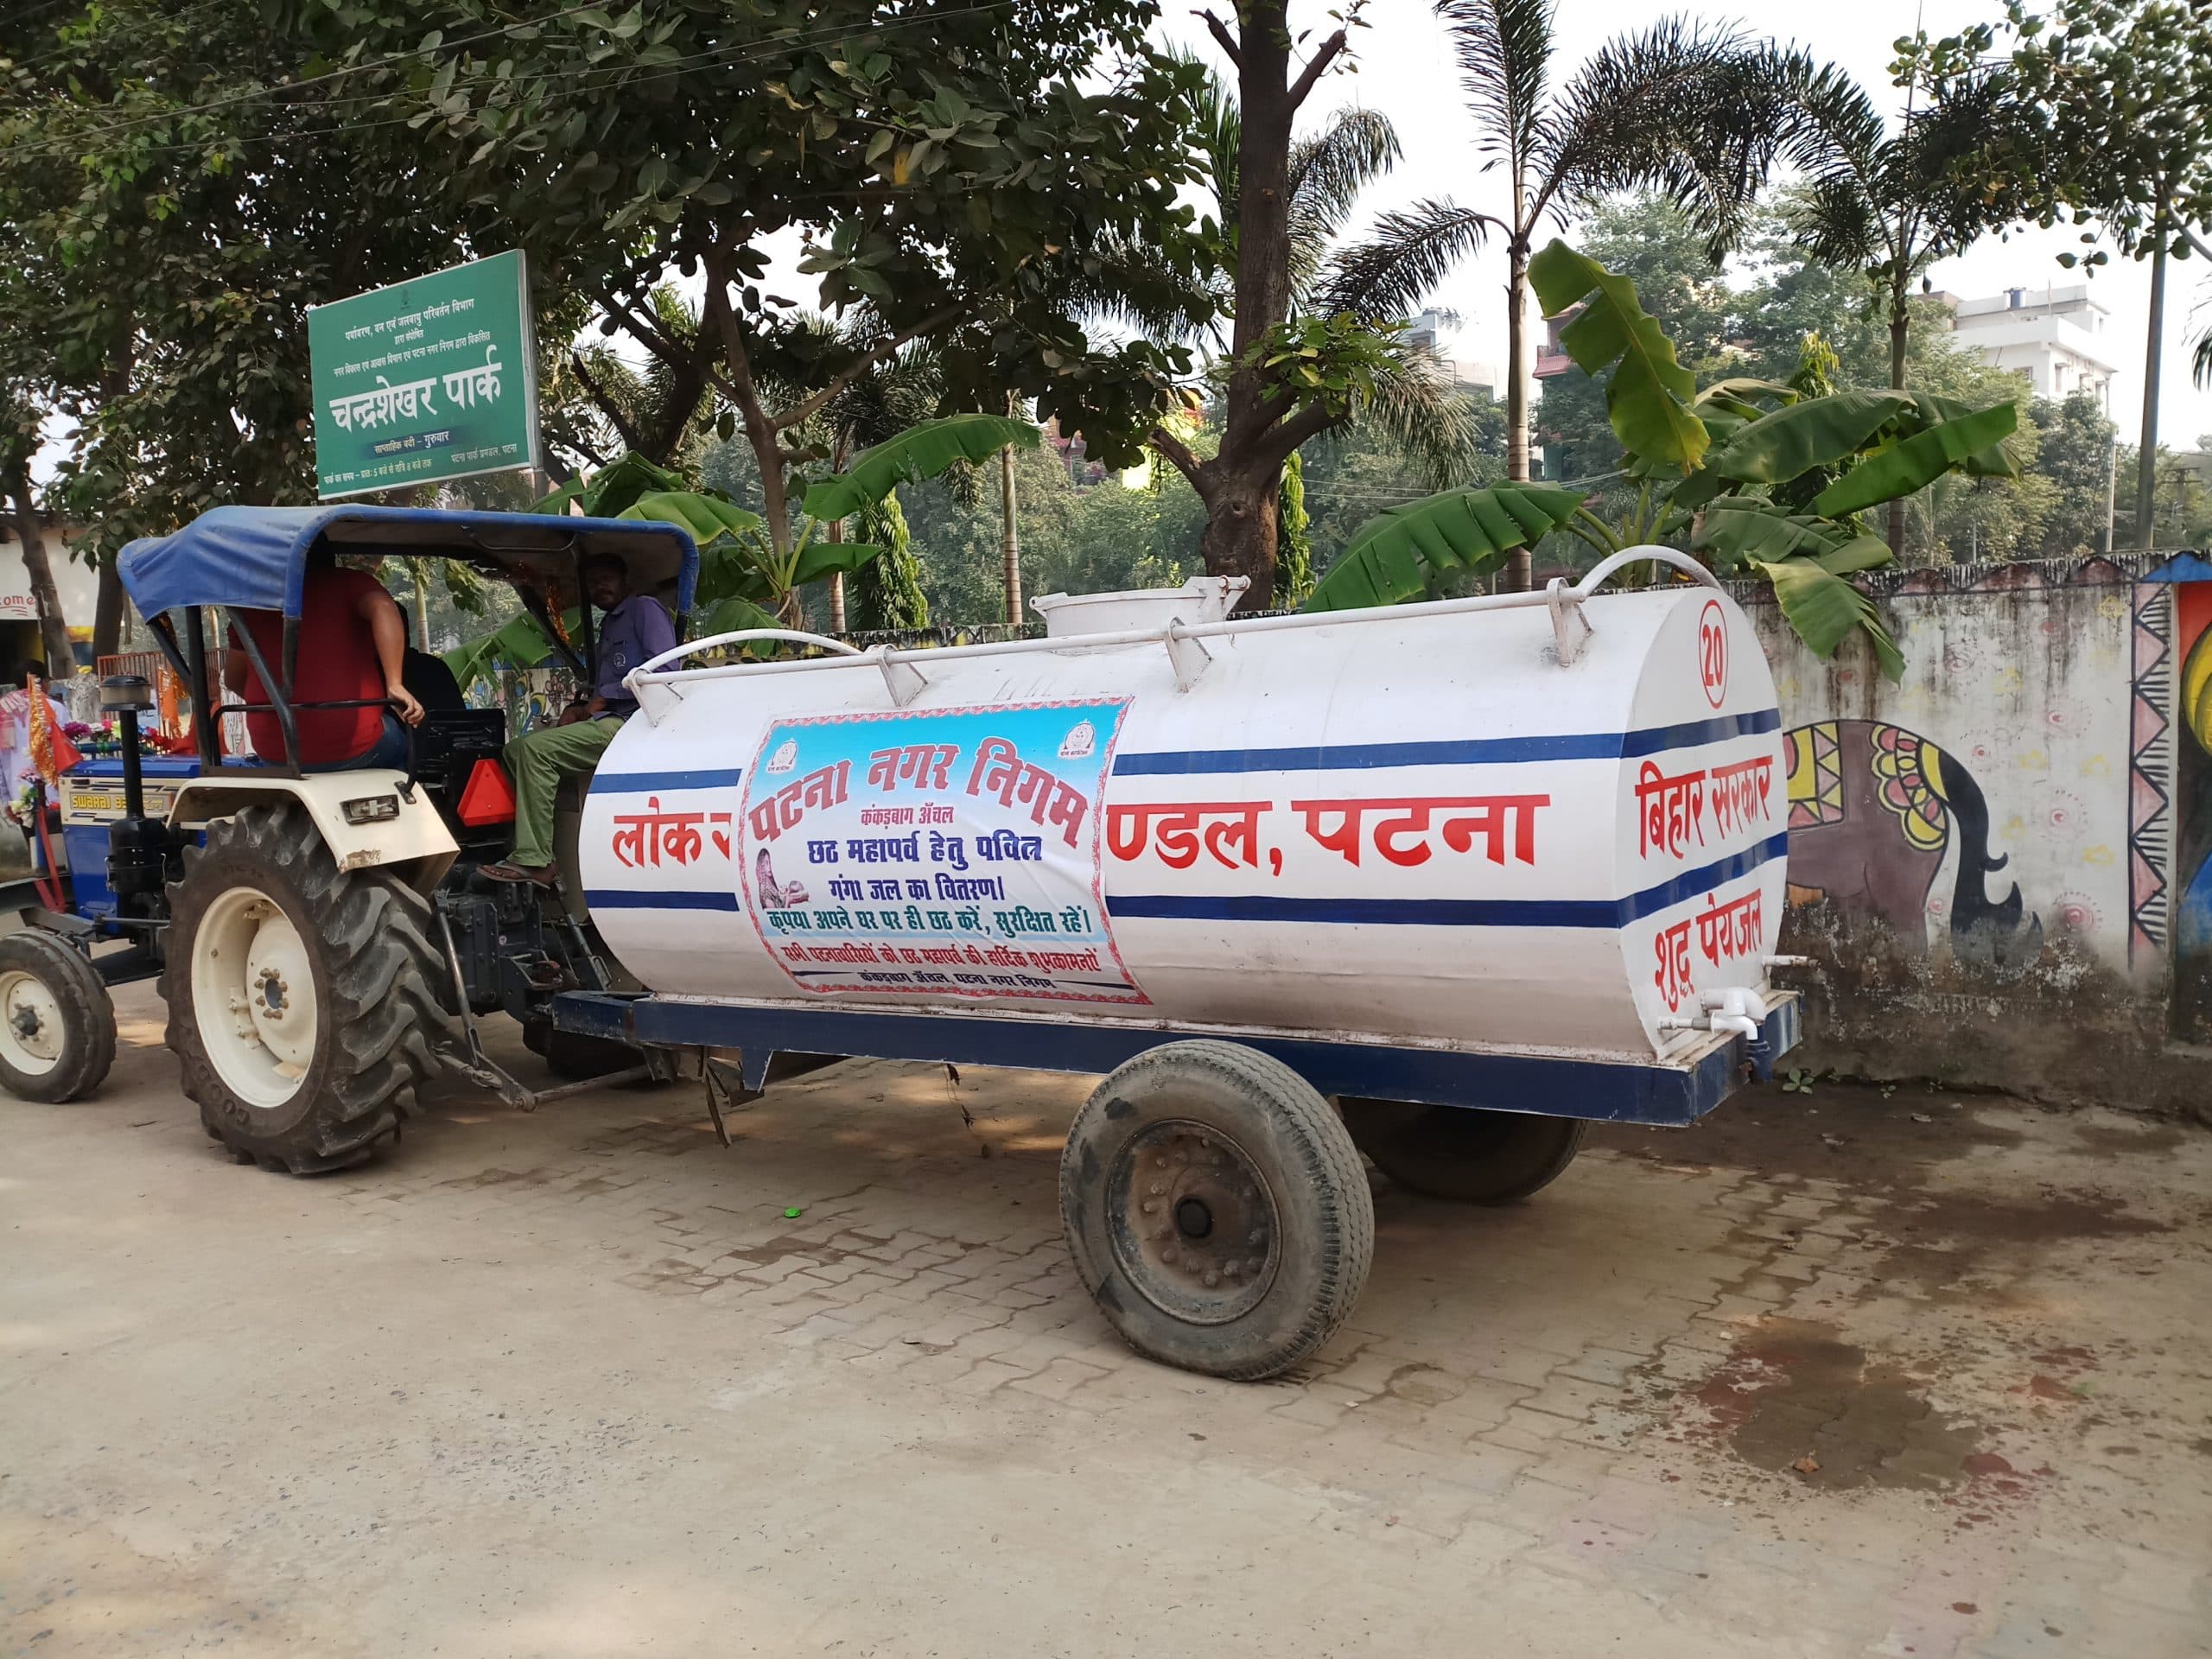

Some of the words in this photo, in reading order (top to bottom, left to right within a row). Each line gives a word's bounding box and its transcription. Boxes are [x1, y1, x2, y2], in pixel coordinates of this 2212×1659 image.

[397, 313, 422, 326] जलवायु
[452, 298, 474, 313] विभाग
[329, 375, 437, 433] चन्द्रशेखर
[442, 344, 502, 410] पार्क
[423, 431, 449, 448] गुरुवार
[0, 595, 35, 606] ome
[1701, 624, 1724, 687] 20
[748, 759, 852, 842] पटना
[868, 745, 961, 791] नगर
[966, 737, 1088, 848] निगम
[1635, 760, 1707, 861] बिहार
[1711, 754, 1774, 837] सरकार
[613, 796, 704, 868] लोक
[807, 840, 838, 864] छठ
[847, 830, 920, 862] महापर्व
[930, 830, 969, 871] हेतु
[1106, 800, 1283, 877] ण्डल,
[1291, 793, 1551, 868] पटना
[829, 874, 863, 901] गंगा
[868, 879, 902, 900] जल
[906, 879, 931, 900] का
[767, 911, 811, 935] कृपया
[814, 906, 854, 930] अपने
[855, 911, 879, 930] घर
[880, 911, 903, 930] पर
[904, 905, 925, 930] ही
[926, 911, 953, 930] छठ
[955, 906, 990, 935] करें,
[994, 906, 1057, 938] सुरक्षित
[1695, 887, 1763, 969] पेयजल
[781, 942, 811, 962] सभी
[807, 942, 880, 964] पटनावासियों
[878, 943, 901, 964] को
[899, 948, 923, 964] छठ
[919, 944, 966, 965] महापर्व
[963, 944, 988, 965] की
[984, 945, 1028, 968] हार्दिक
[953, 973, 988, 985] पटना
[987, 975, 1018, 987] नगर
[1015, 974, 1057, 988] निगम
